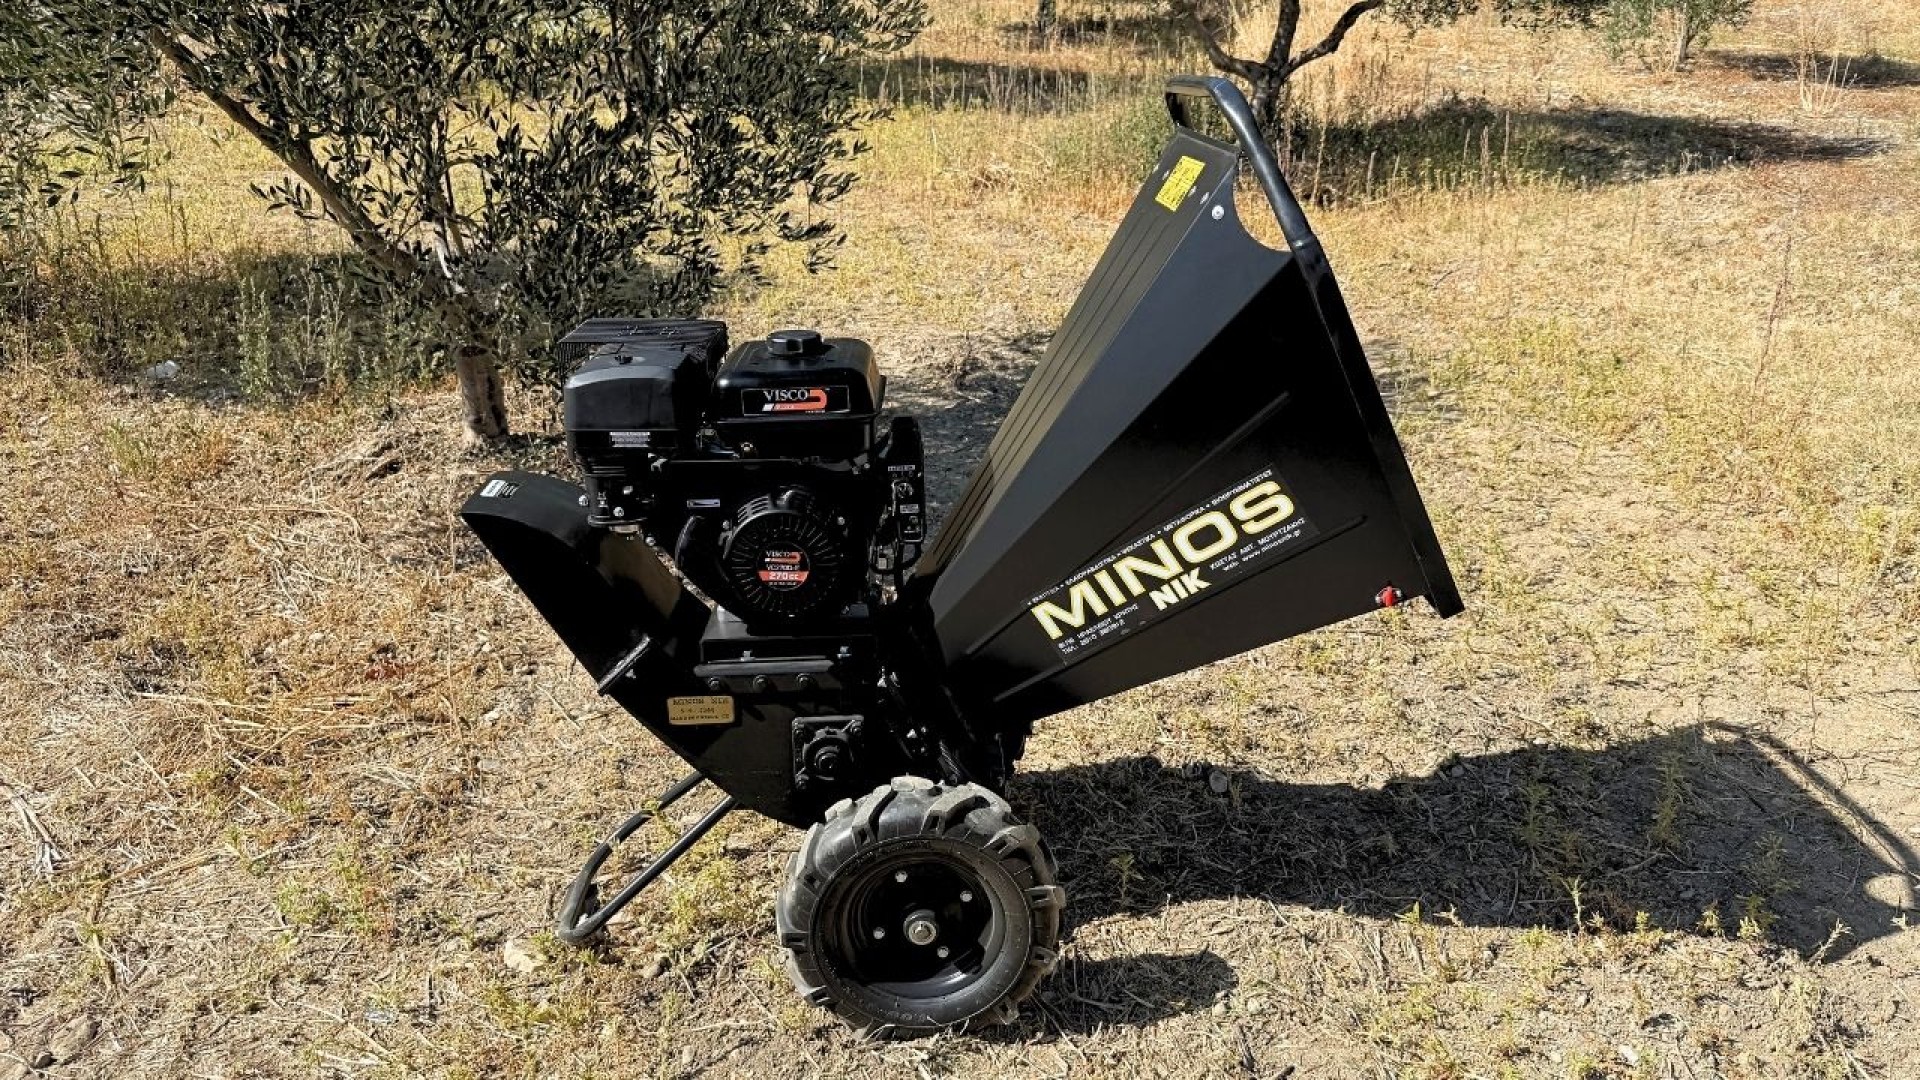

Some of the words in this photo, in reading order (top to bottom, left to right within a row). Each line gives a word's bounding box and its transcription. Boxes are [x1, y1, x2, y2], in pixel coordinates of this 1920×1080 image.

[763, 388, 808, 401] VISCO
[1031, 480, 1295, 640] MINOS
[1149, 567, 1212, 611] NIK
